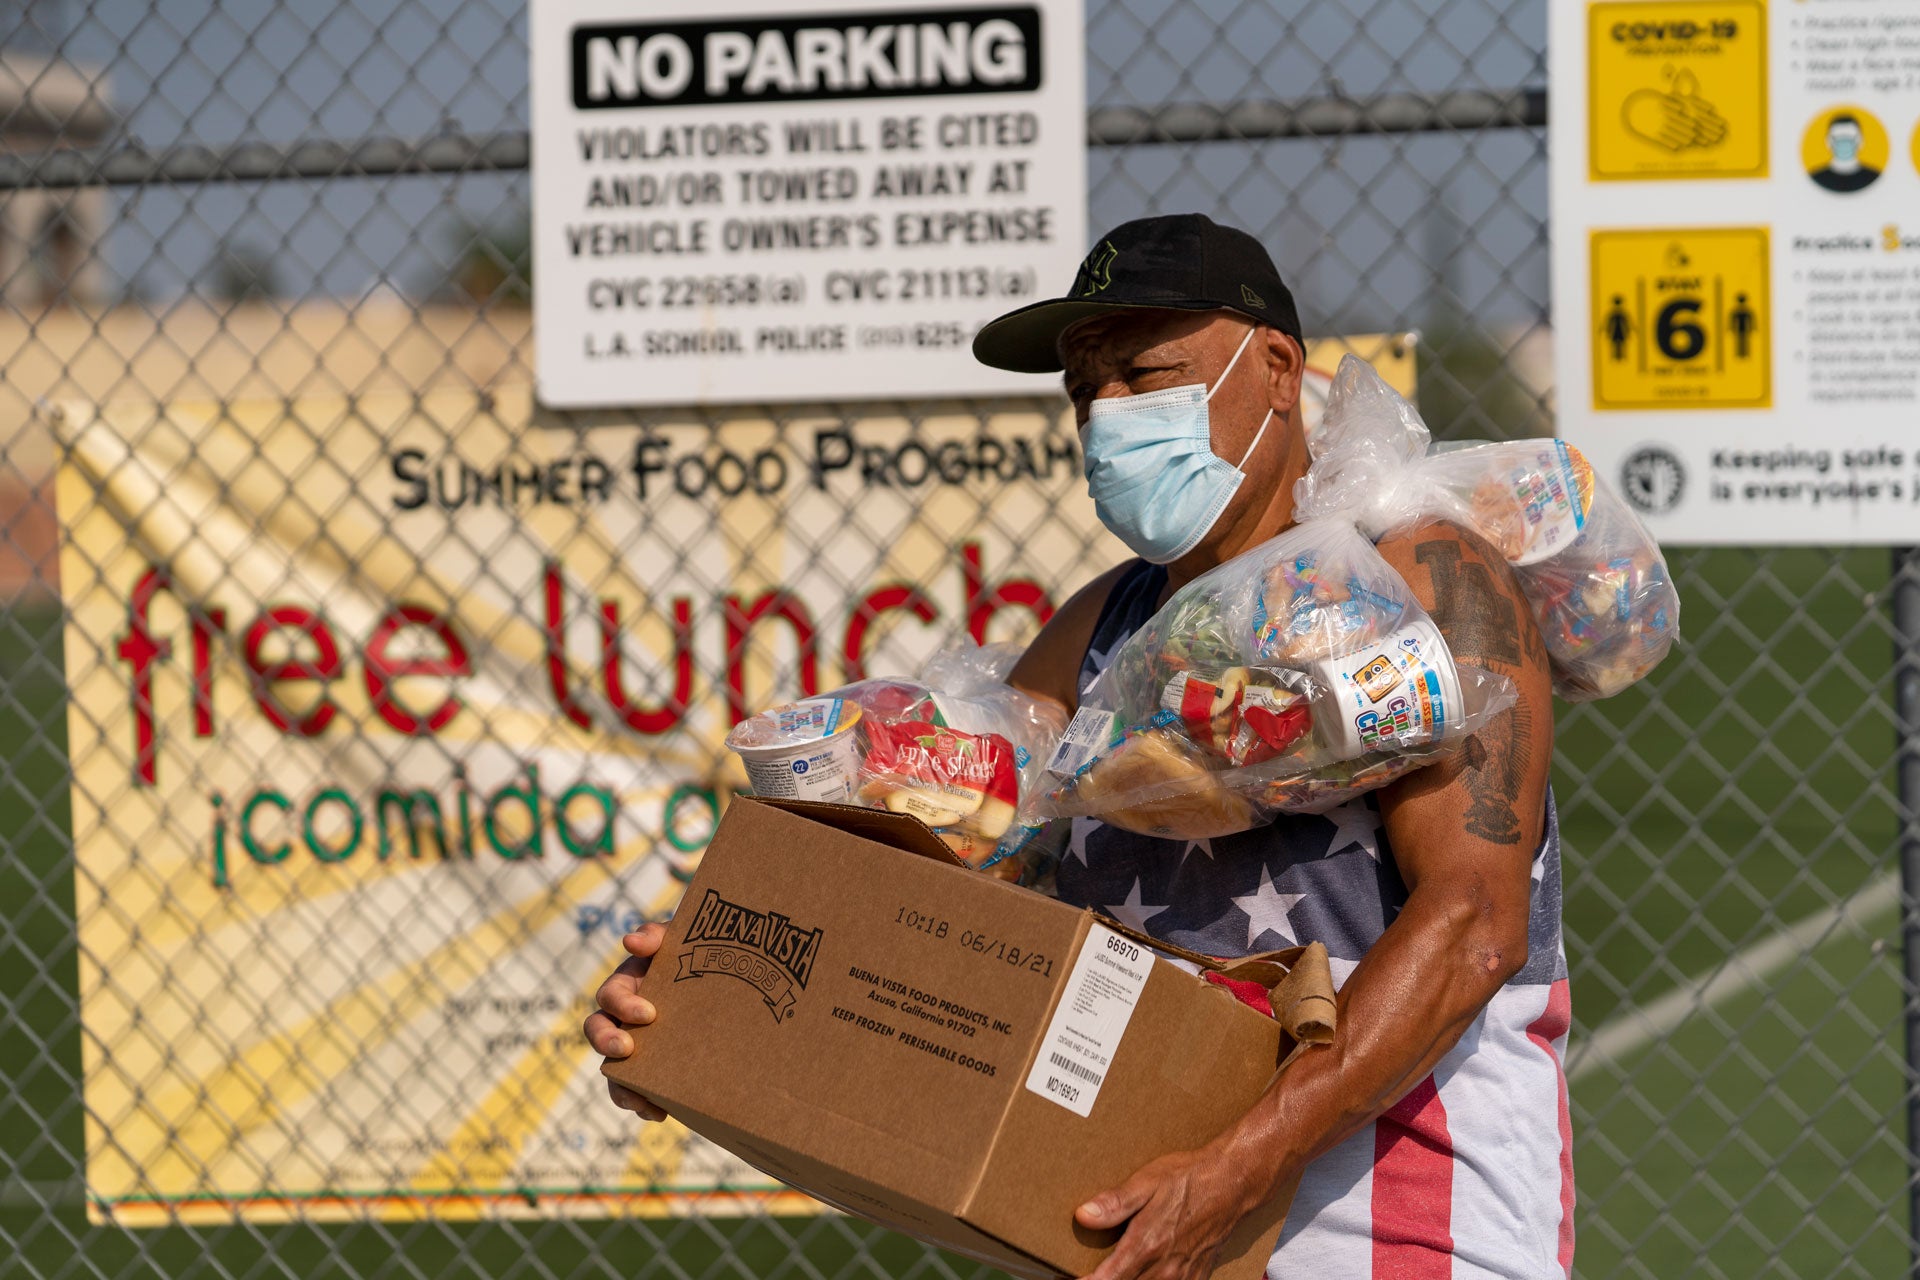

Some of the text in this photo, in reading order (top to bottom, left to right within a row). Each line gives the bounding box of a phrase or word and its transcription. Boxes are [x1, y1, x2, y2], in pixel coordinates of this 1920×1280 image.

[1611, 19, 1738, 42] COVID-19
[586, 19, 1027, 99] NO PARKING
[578, 112, 1039, 161] VIOLATORS WILL BE CITED
[586, 161, 1032, 209] AND/OR TOWED AWAY AT
[567, 208, 1055, 258] VEHICLE OWNER'S EXPENSE
[588, 278, 651, 310] CVC
[824, 269, 890, 302] CVC
[642, 328, 743, 358] SCHOOL
[756, 325, 846, 354] POLICE
[1655, 297, 1706, 361] 6
[631, 431, 789, 501] FOOD
[814, 427, 1080, 492] PROGRAM
[1710, 444, 1832, 474] Keeping
[1842, 445, 1905, 468] safe
[1710, 475, 1731, 500] is
[1743, 476, 1903, 505] everyone's
[116, 564, 474, 787] free
[1421, 695, 1432, 716] LESS
[947, 752, 996, 780] Slices
[207, 762, 618, 889] ¡comida
[682, 888, 824, 991] BUENA VISTA
[895, 907, 1054, 978] 10:18 06/18/21
[1106, 935, 1140, 962] 66970
[703, 948, 781, 991] FOODS
[849, 966, 1013, 1036] BUENA VISTA FOOD PRODUCTS, INC.
[867, 989, 976, 1039] Azusa, California 91702
[831, 1006, 997, 1078] KEEP FROZEN PERISHABLE GOODS
[1045, 1075, 1081, 1103] MD/169/21
